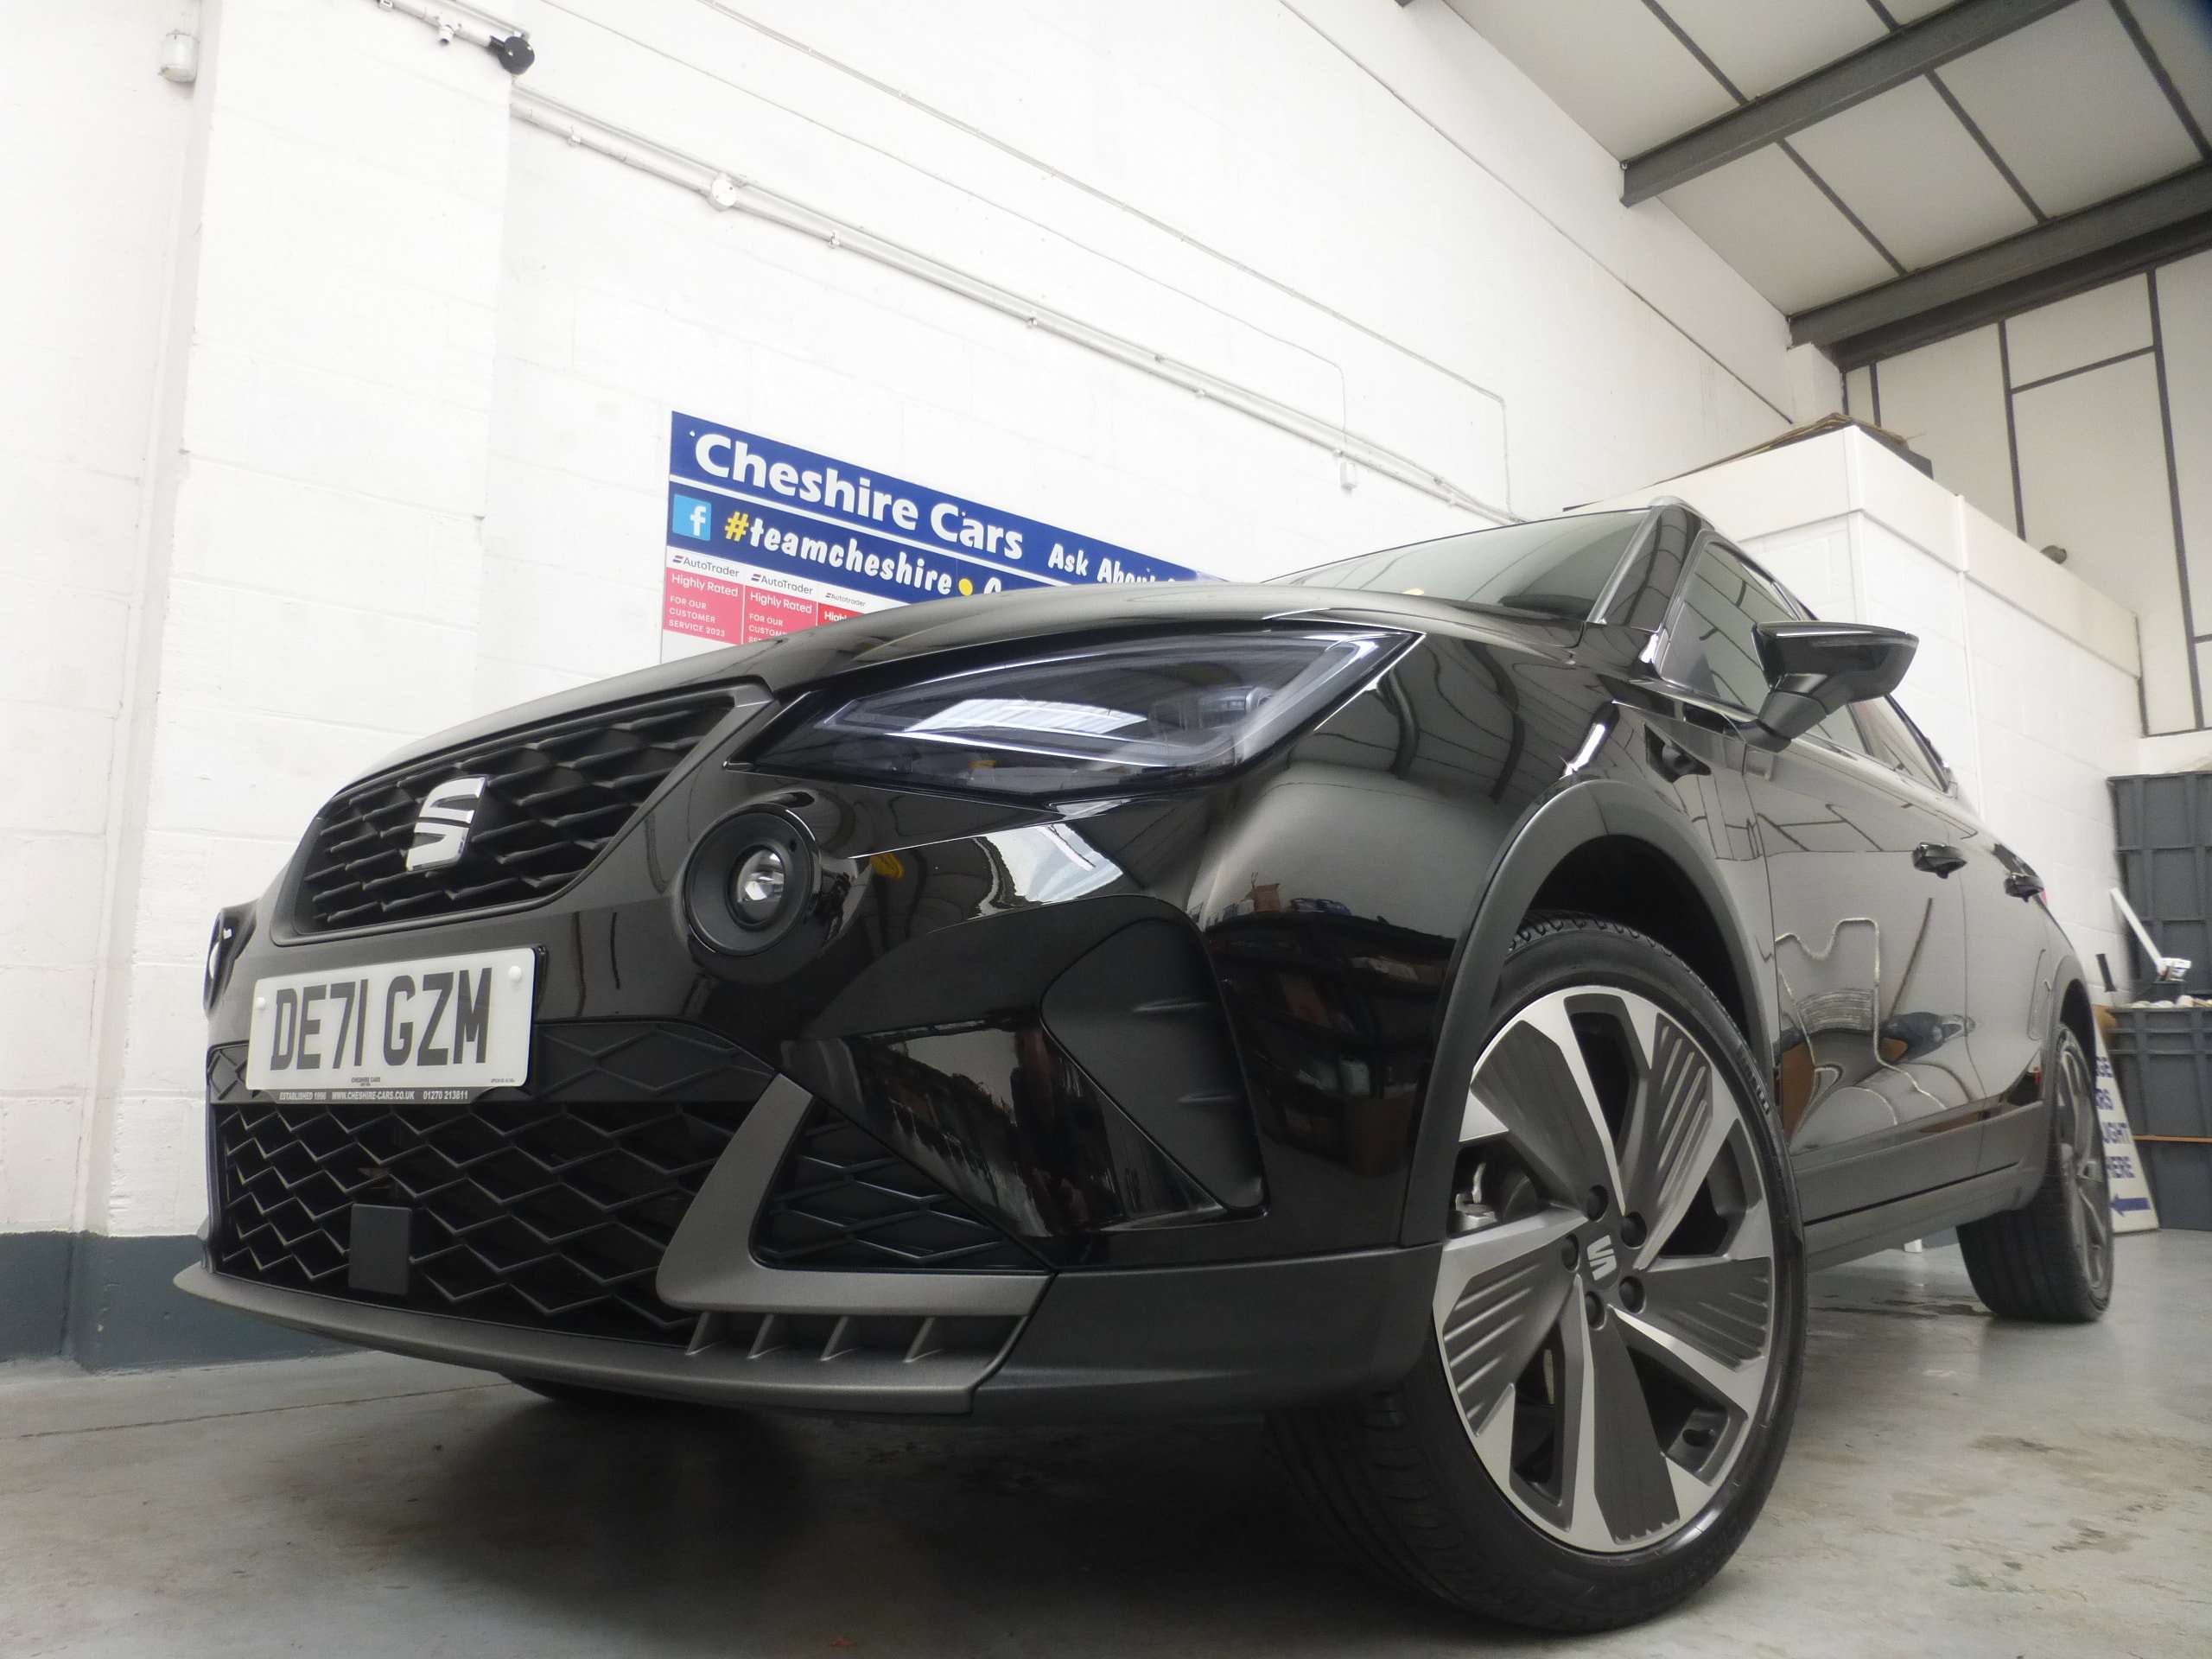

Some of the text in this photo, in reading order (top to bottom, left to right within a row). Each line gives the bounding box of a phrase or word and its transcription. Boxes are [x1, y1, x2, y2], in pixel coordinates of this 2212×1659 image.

[694, 433, 1023, 560] Cheshire Cars
[724, 512, 952, 595] #teamcheshire
[1047, 543, 1089, 576] Ask
[683, 557, 741, 577] AutoTrader
[671, 574, 739, 597] Highly Rated
[760, 575, 814, 595] AutoTrader
[670, 595, 707, 609] FOR OUR
[750, 591, 812, 614] Highly Rated
[669, 607, 715, 623] CUSTOMER
[749, 613, 784, 627] FOR OUR
[669, 620, 704, 632] SERVICE
[270, 967, 493, 1071] DE71 GZM
